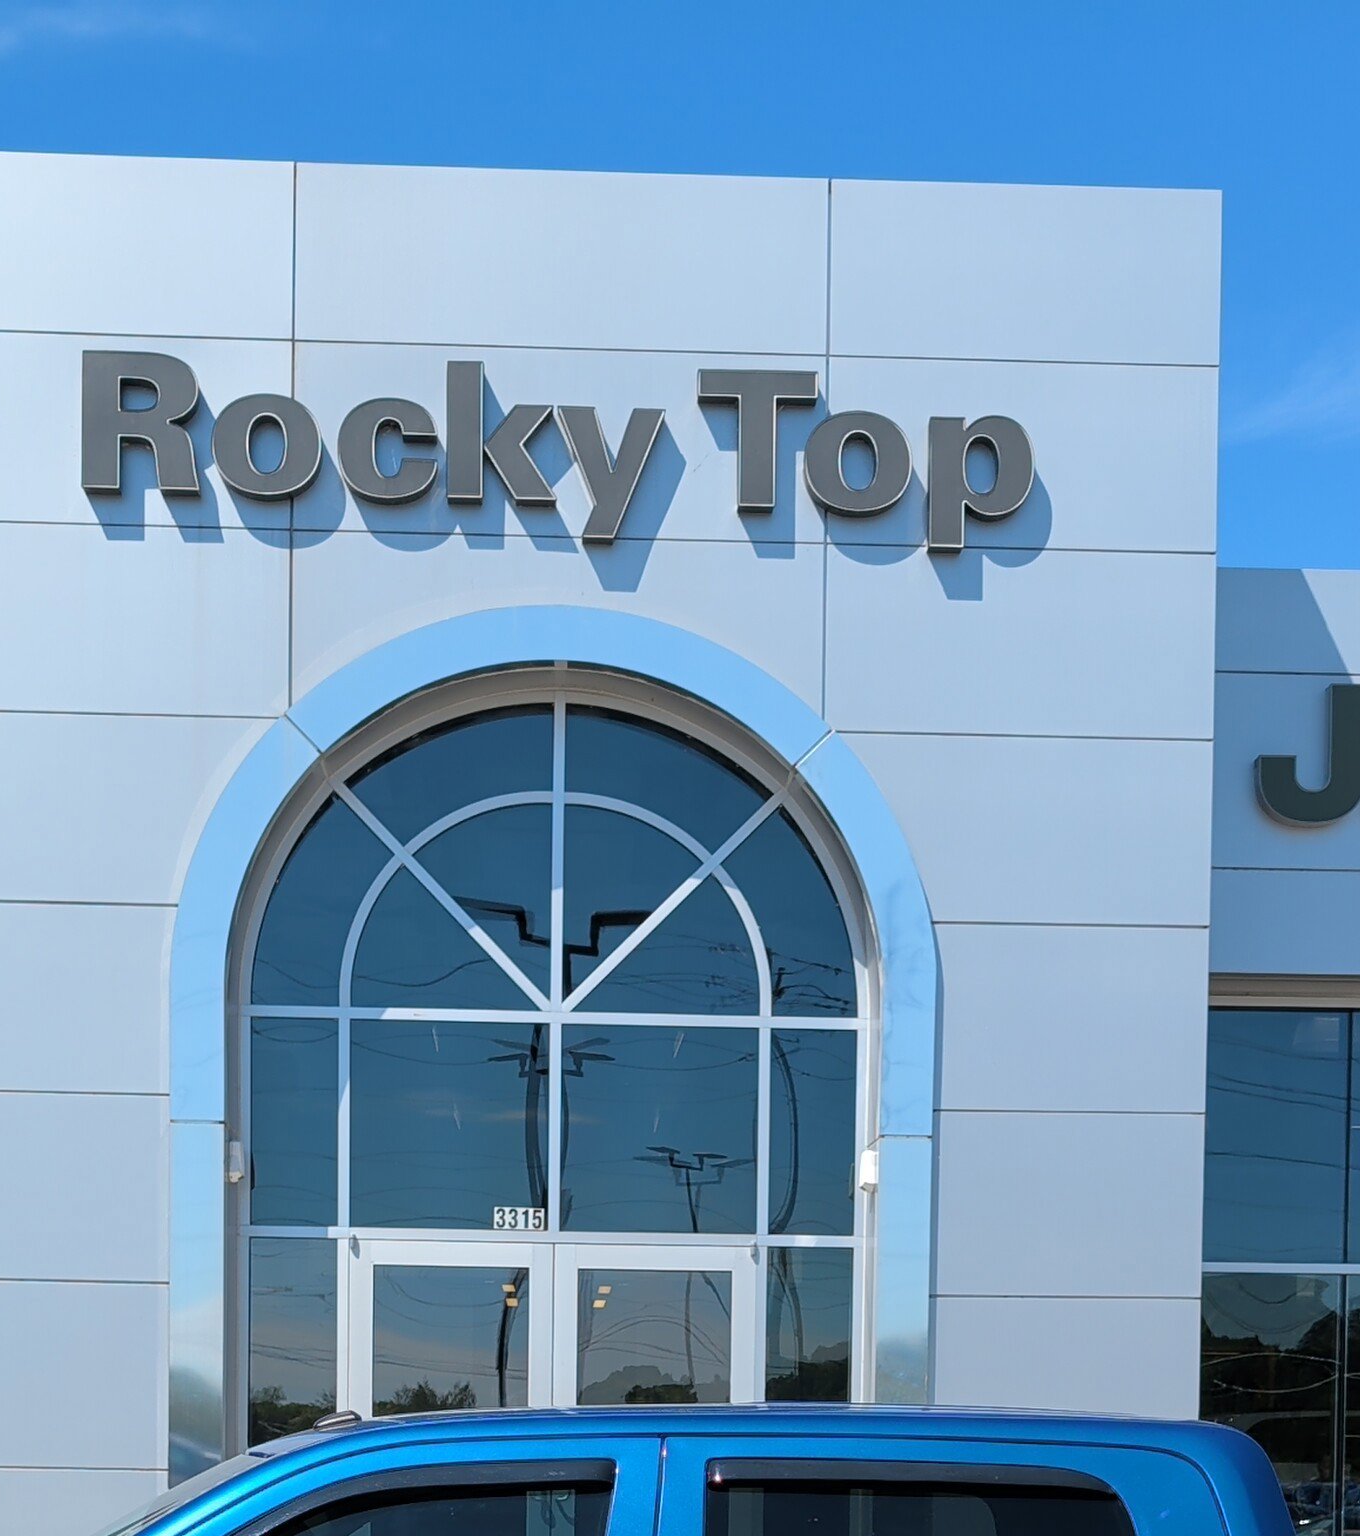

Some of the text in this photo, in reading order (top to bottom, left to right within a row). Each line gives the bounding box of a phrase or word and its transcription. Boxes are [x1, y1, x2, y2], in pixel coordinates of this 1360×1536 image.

[81, 350, 1036, 553] Rocky Top
[495, 1208, 543, 1229] 3315
